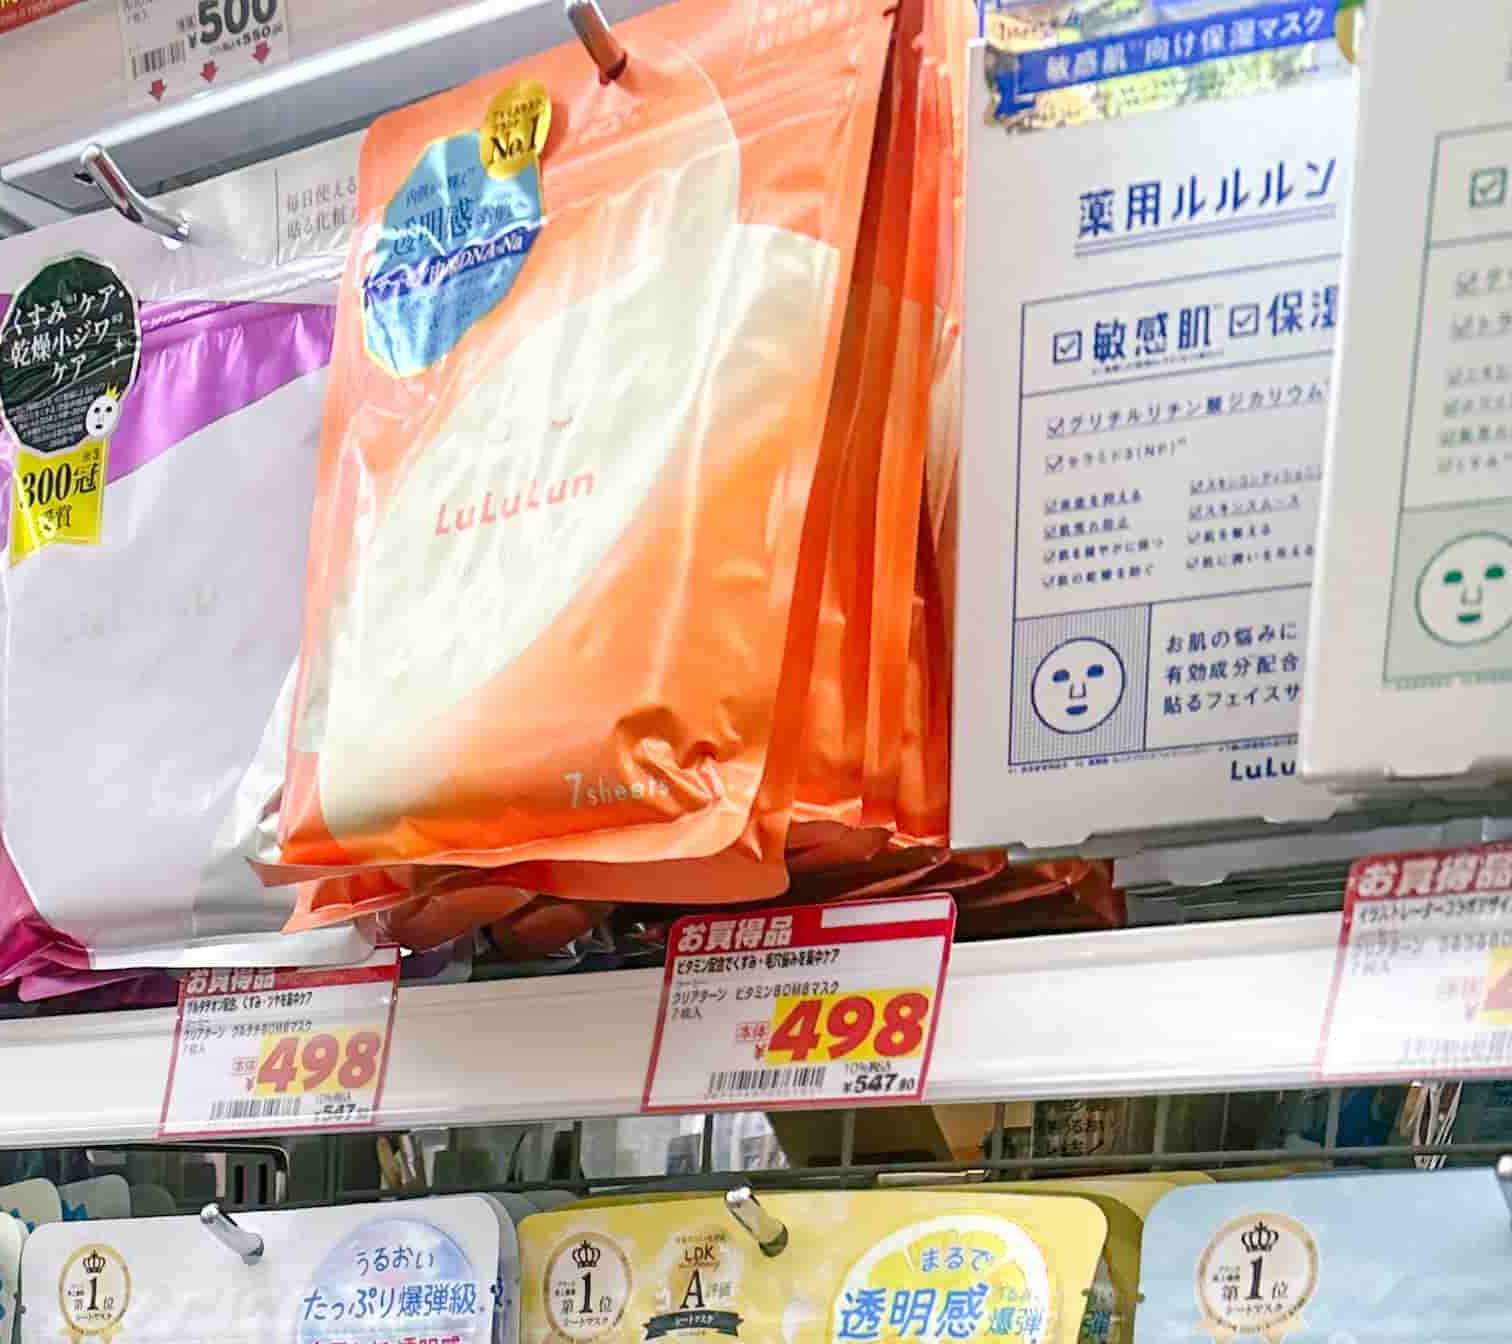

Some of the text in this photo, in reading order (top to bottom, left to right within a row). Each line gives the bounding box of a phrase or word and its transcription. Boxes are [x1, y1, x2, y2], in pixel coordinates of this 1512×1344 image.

[767, 992, 926, 1061] 498
[257, 1031, 381, 1092] 498
[839, 1283, 989, 1341] 透明感
